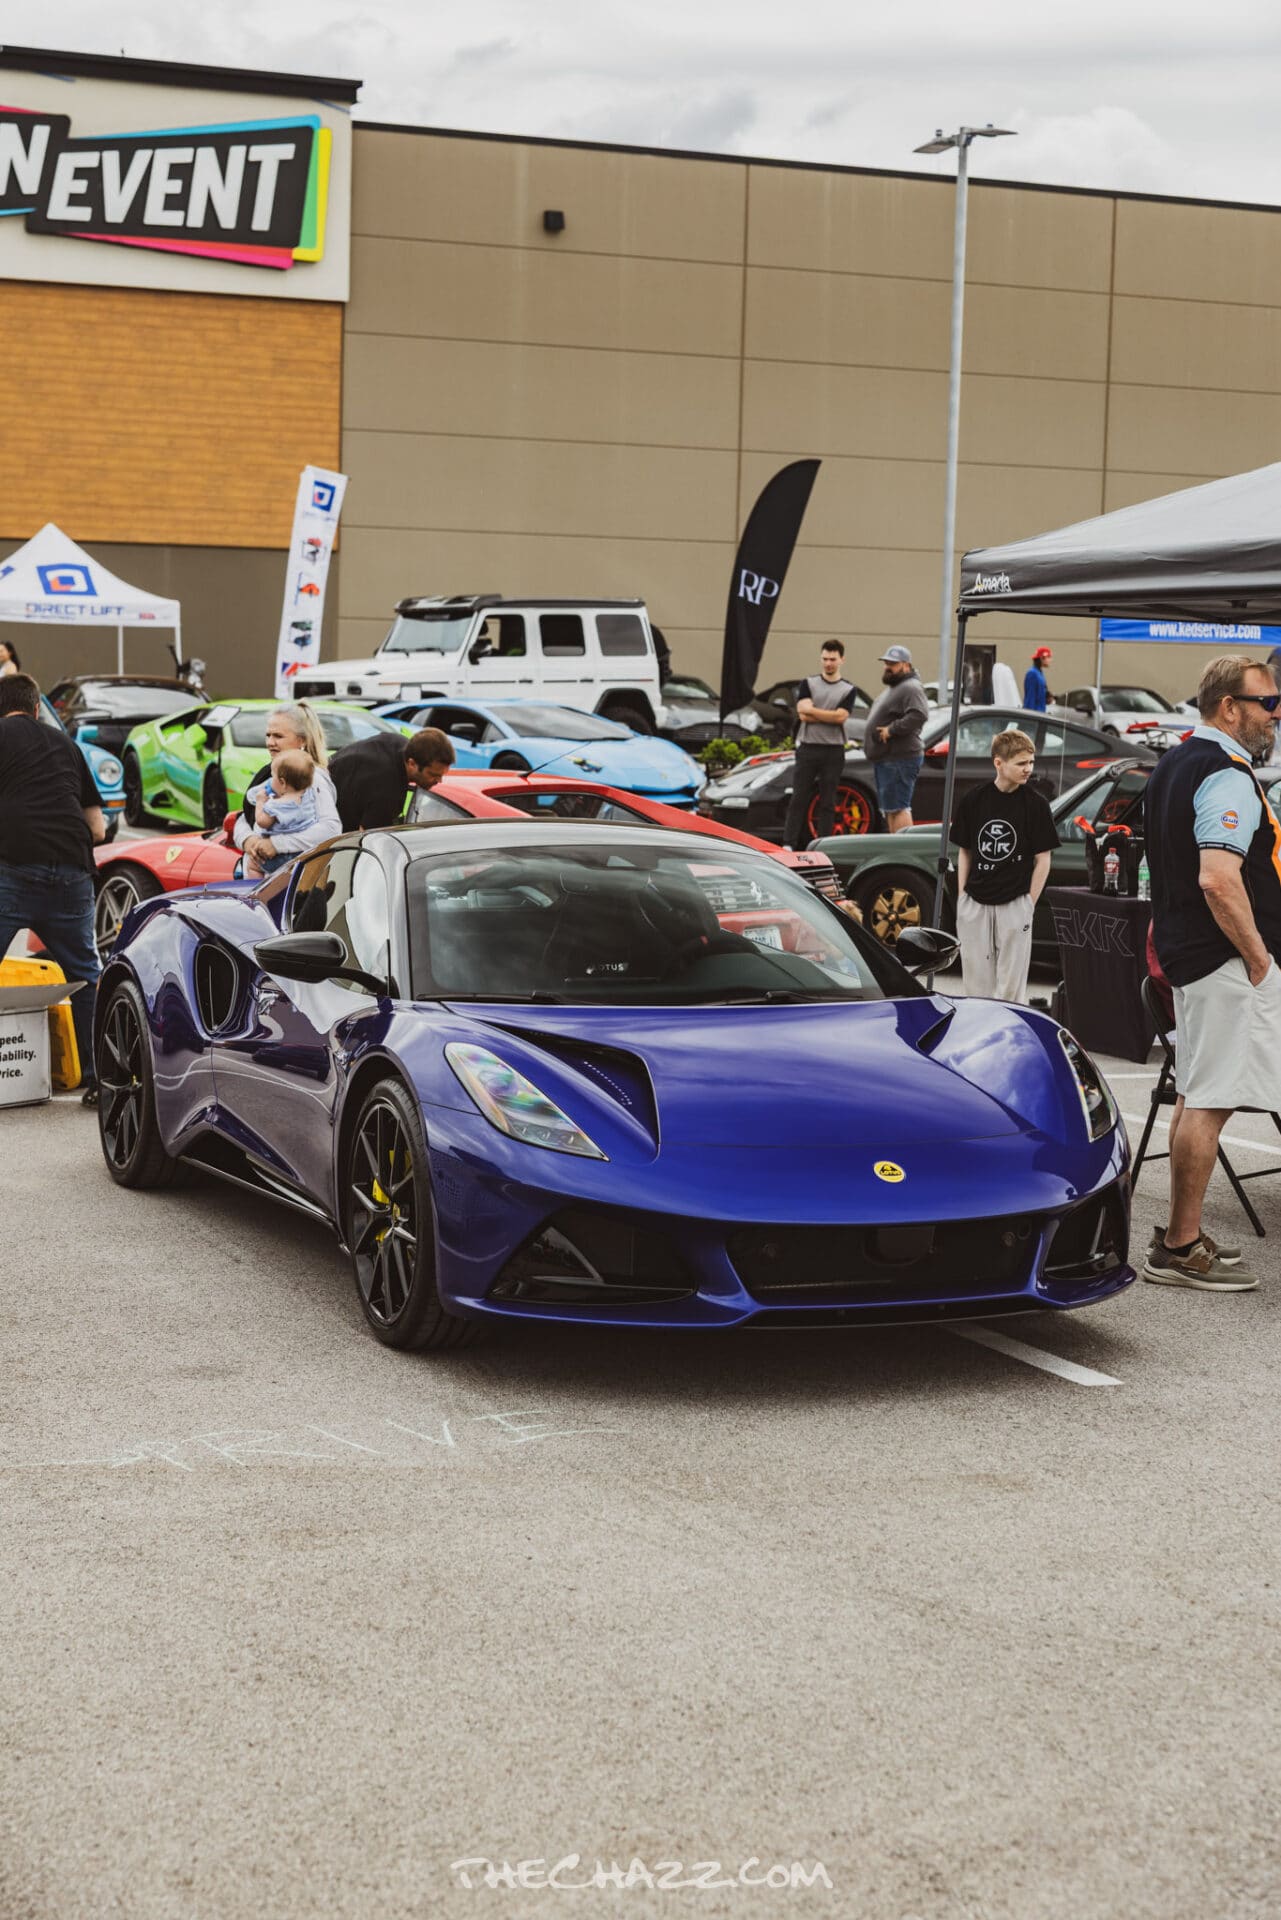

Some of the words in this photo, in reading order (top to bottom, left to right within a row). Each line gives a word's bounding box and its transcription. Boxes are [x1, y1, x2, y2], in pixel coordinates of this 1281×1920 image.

[46, 143, 296, 232] EVENT
[738, 569, 780, 605] RP
[1150, 622, 1261, 640] www.kedservice.com
